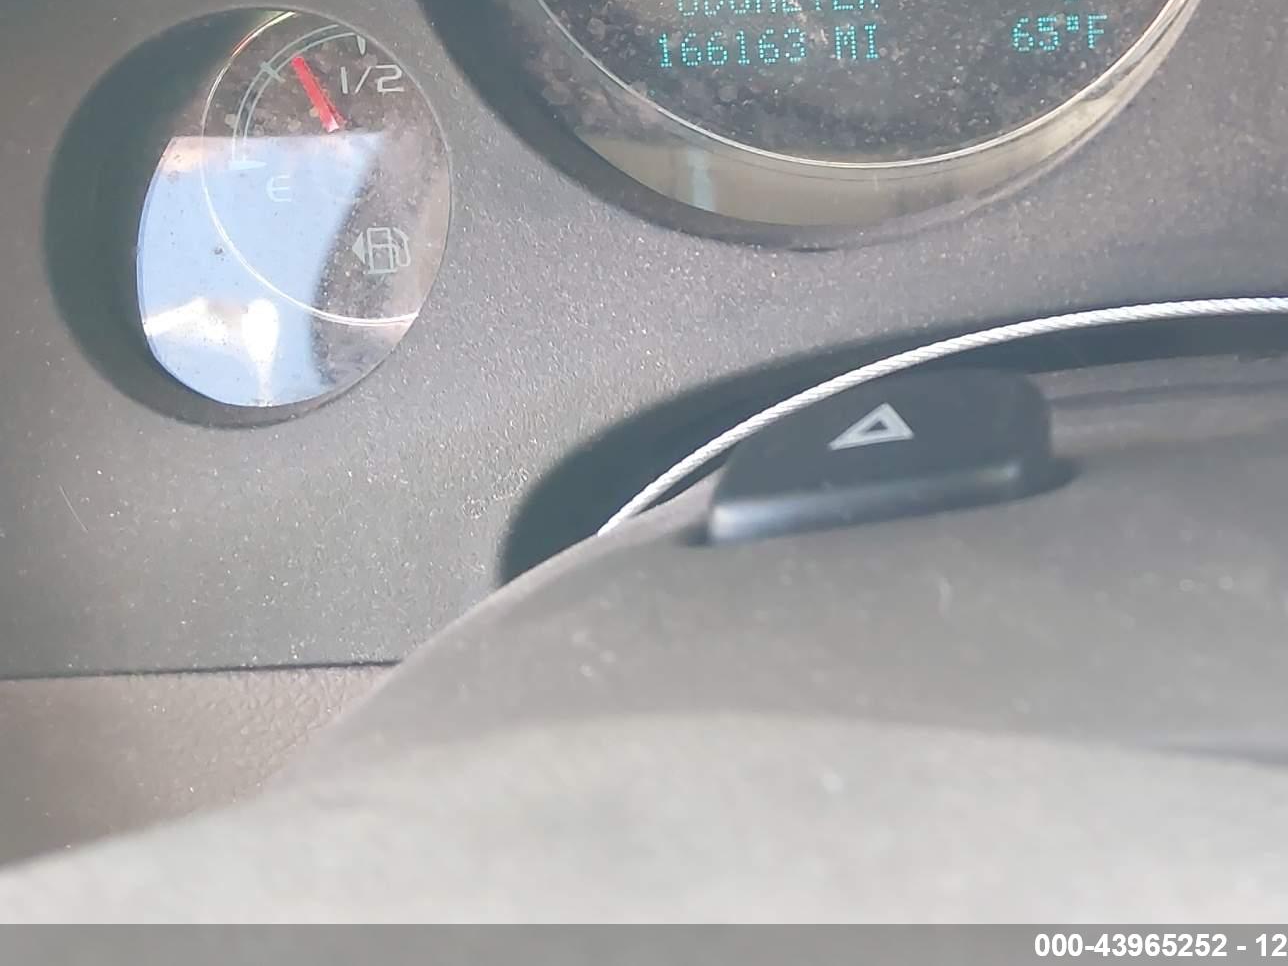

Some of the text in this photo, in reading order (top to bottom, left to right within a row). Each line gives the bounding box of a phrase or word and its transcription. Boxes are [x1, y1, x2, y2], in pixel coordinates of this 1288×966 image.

[658, 24, 879, 68] 166163 MI
[1011, 14, 1108, 52] 65°F
[340, 64, 405, 95] 1/2
[266, 174, 292, 203] E
